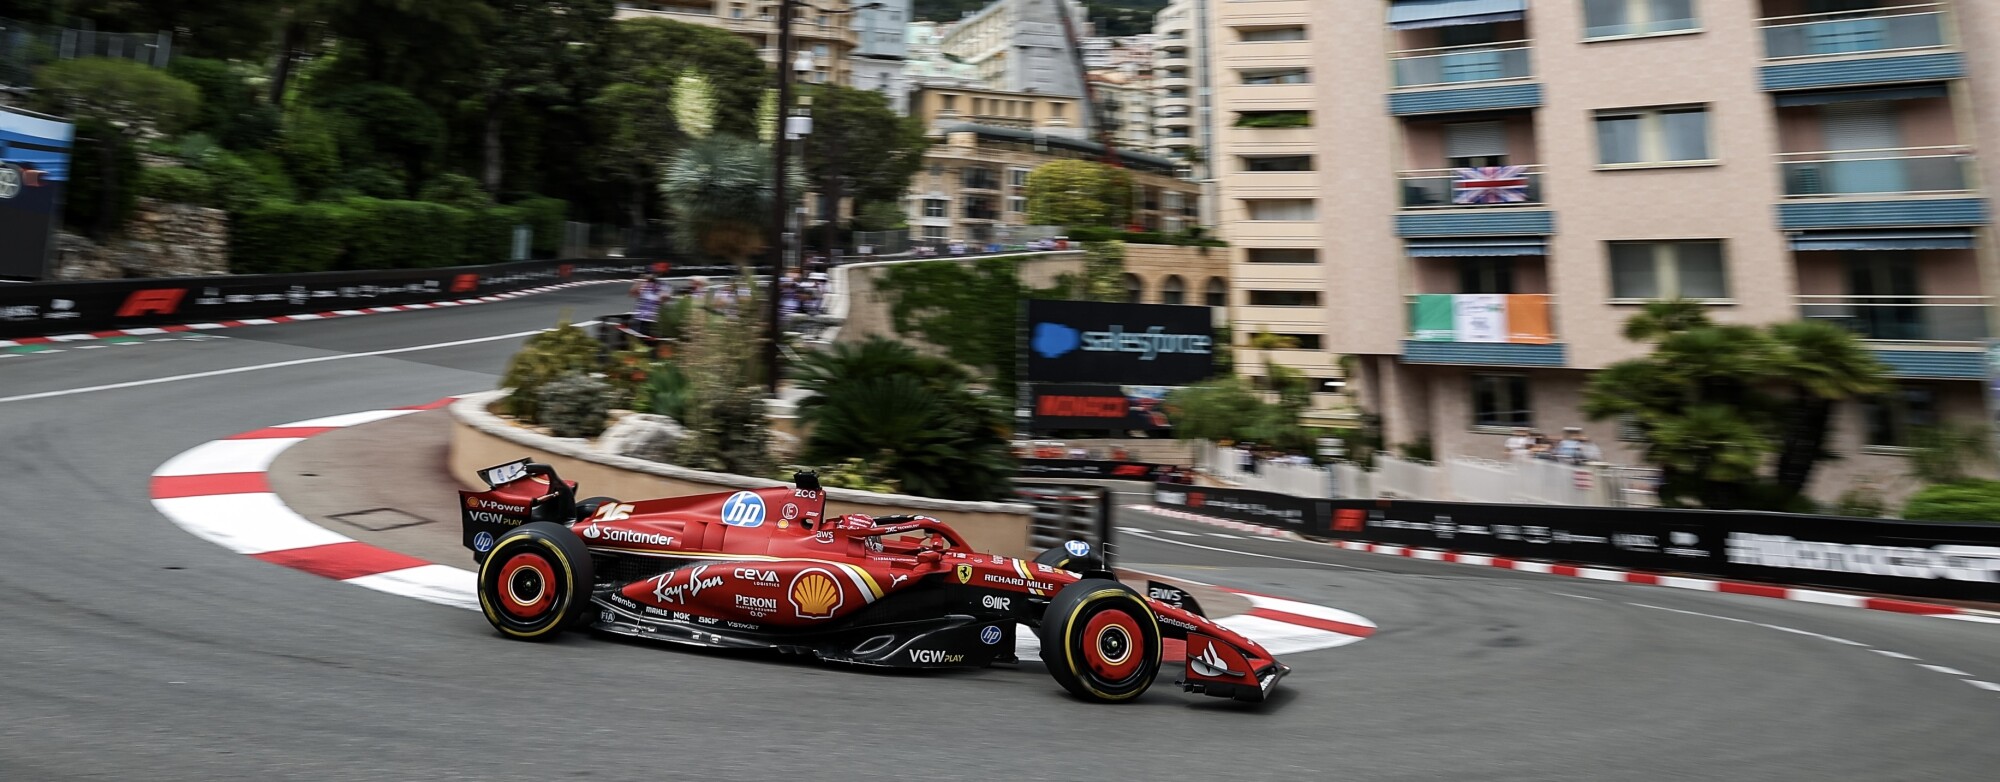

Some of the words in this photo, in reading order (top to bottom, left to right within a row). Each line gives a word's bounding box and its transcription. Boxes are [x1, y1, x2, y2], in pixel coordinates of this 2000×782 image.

[1080, 325, 1212, 361] salesforce
[794, 488, 817, 499] ZCG
[479, 499, 525, 513] V-Power
[724, 491, 763, 526] hp
[469, 510, 503, 524] VGW
[503, 518, 522, 526] PLAY
[475, 532, 493, 552] hp
[602, 527, 674, 546] Santander
[816, 530, 834, 539] aws
[984, 573, 1024, 586] RICHARD
[1026, 580, 1054, 591] MILLE
[611, 593, 637, 609] brembo
[735, 594, 777, 609] PERONI
[645, 606, 668, 617] MAHLE
[673, 611, 690, 620] NGK
[698, 616, 719, 625] SKF
[1158, 614, 1198, 632] Santander
[981, 626, 1001, 645] hp
[908, 649, 946, 663] VGW
[943, 654, 964, 663] PLAY
